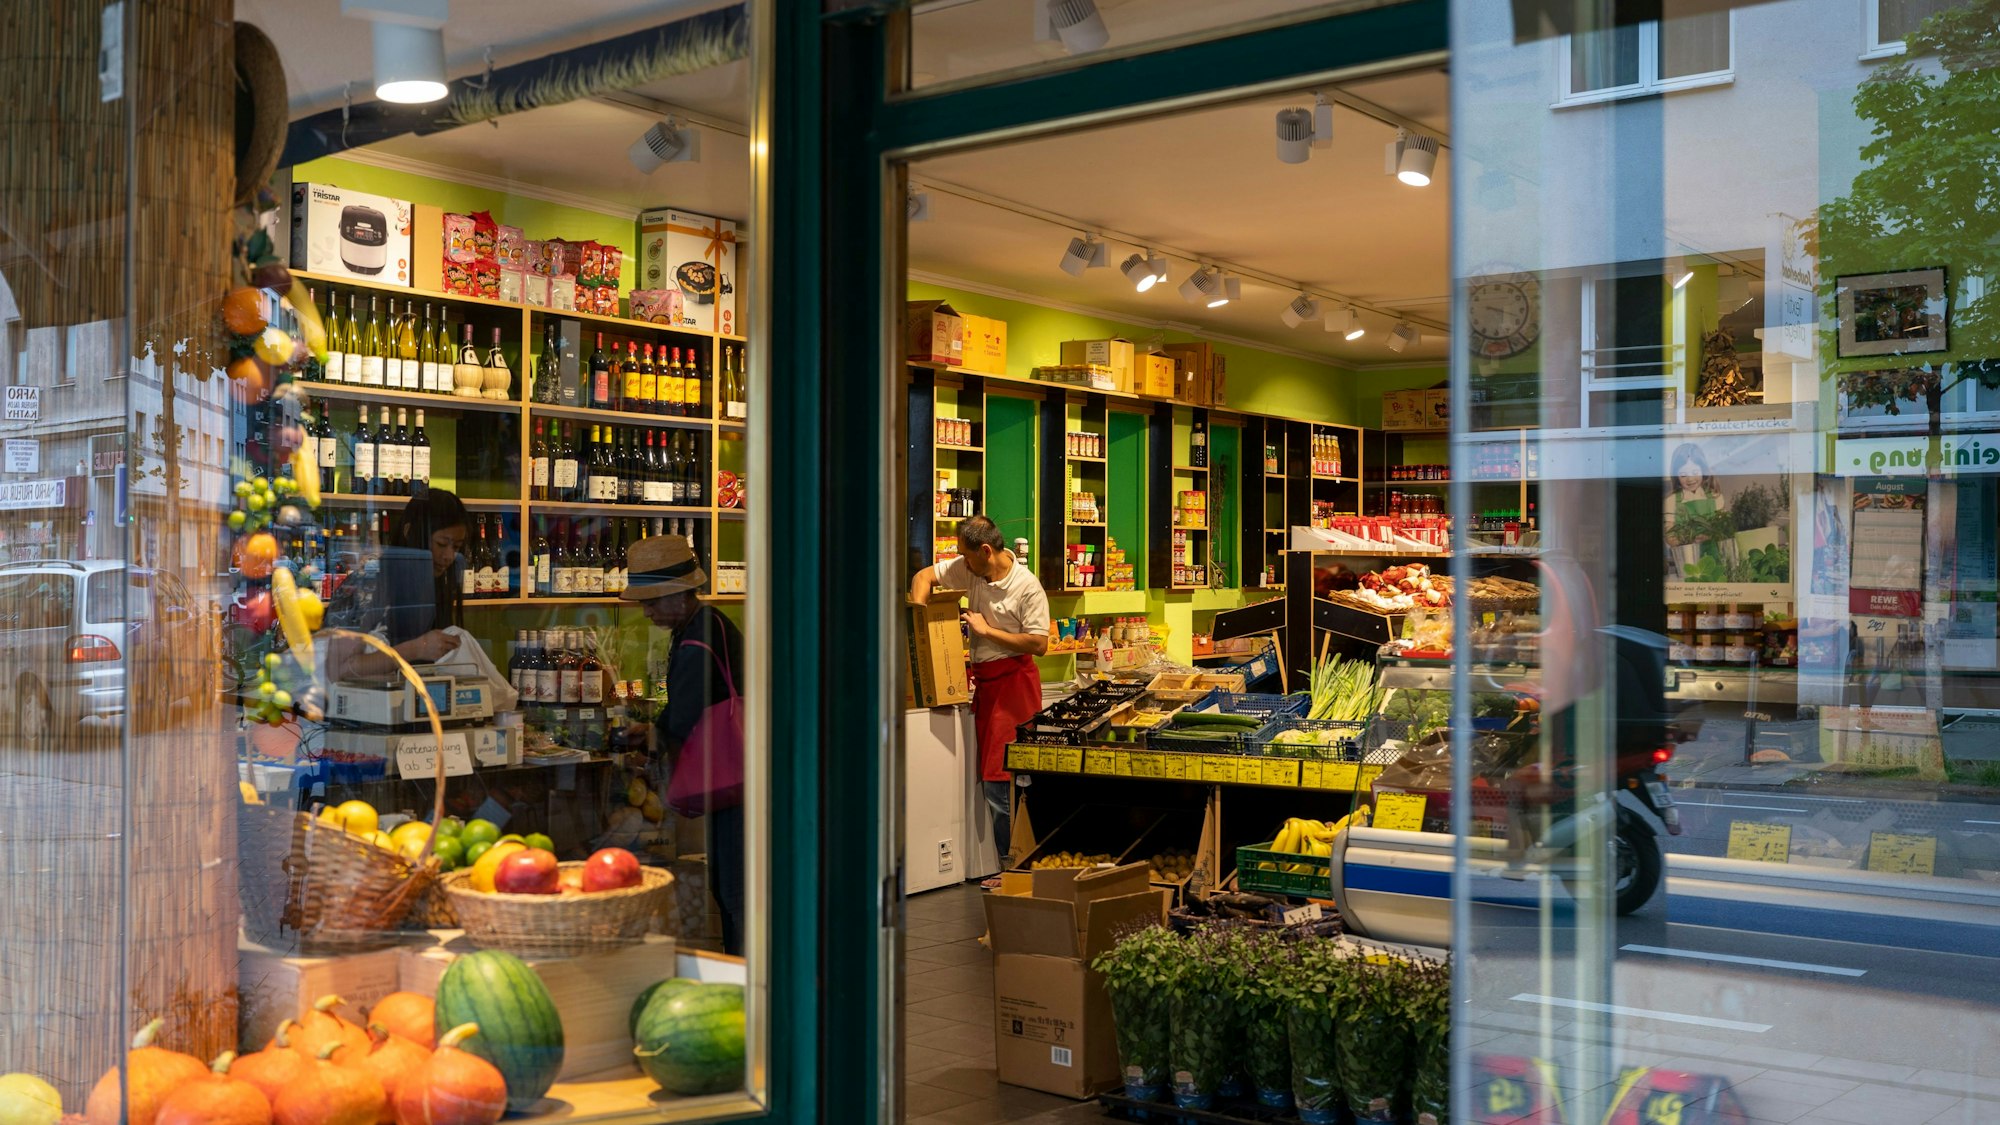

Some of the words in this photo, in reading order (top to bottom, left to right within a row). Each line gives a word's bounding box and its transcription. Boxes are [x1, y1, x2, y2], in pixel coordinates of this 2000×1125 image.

[312, 190, 341, 202] TRISTAR
[1875, 481, 1904, 492] August
[1870, 595, 1898, 604] REWE
[404, 759, 420, 772] ab
